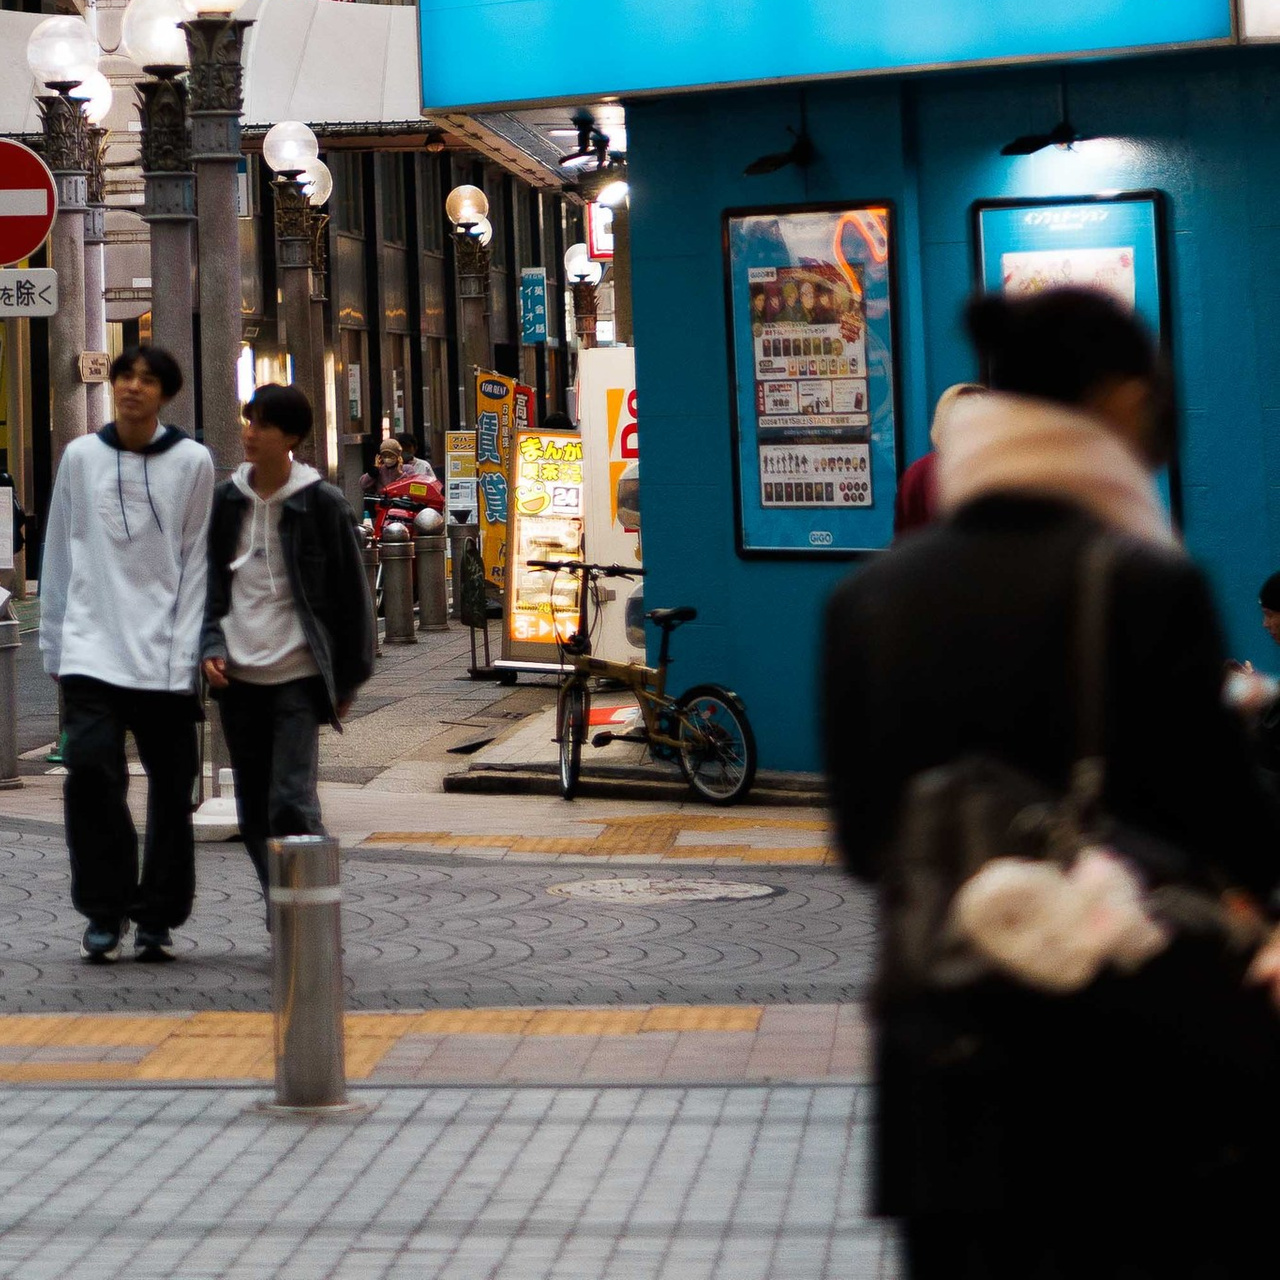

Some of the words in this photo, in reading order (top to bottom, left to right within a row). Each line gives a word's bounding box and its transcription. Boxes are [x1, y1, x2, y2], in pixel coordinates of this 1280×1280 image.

[524, 285, 535, 334] イーオン
[534, 285, 545, 334] 英会話
[520, 437, 583, 461] まんが
